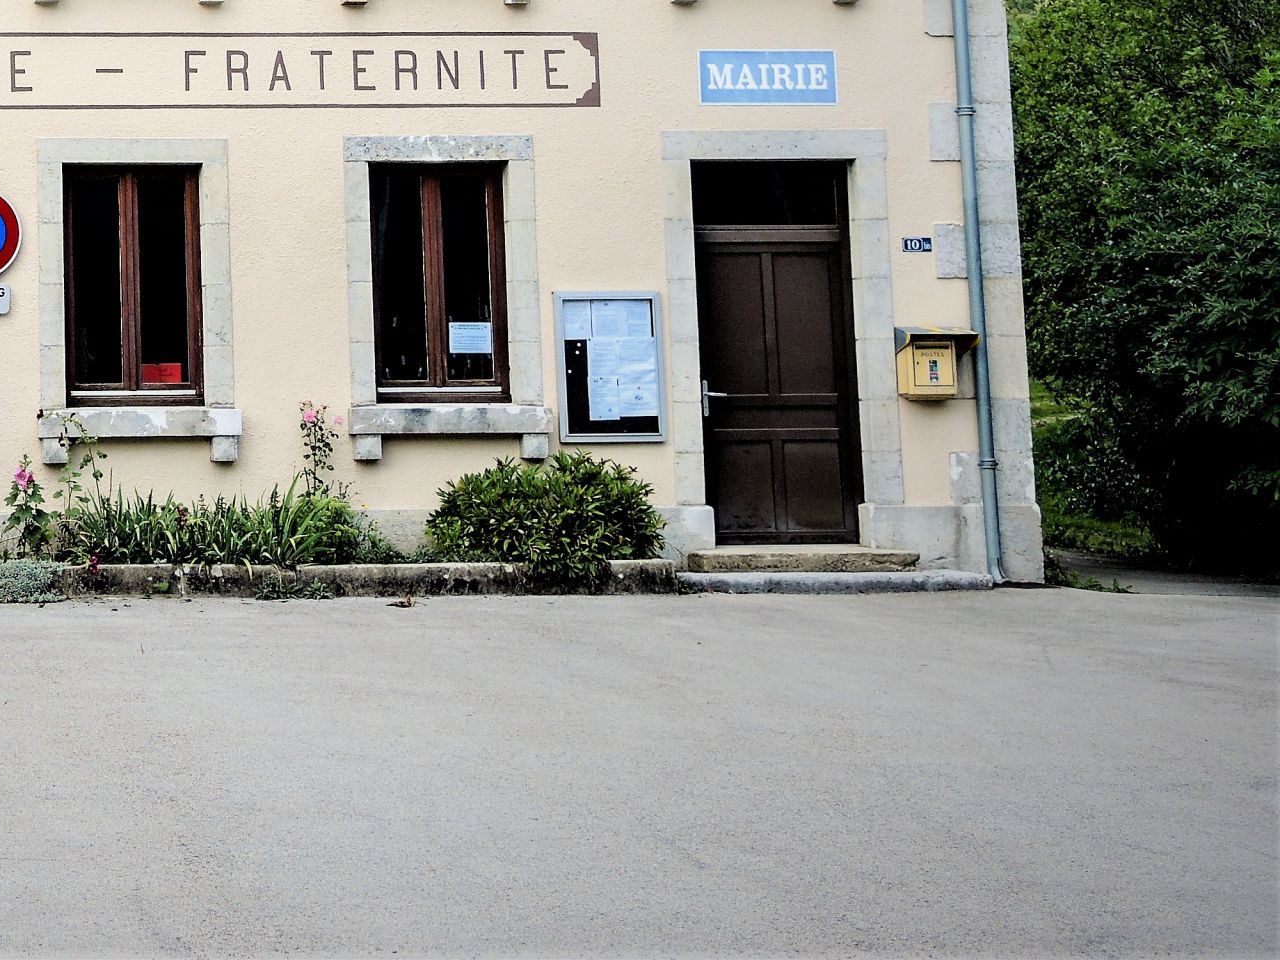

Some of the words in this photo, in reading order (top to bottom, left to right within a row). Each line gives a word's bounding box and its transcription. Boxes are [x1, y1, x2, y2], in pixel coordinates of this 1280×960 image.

[184, 49, 570, 92] FRATERNITE
[706, 63, 828, 90] MAIRIE
[907, 239, 920, 249] 10
